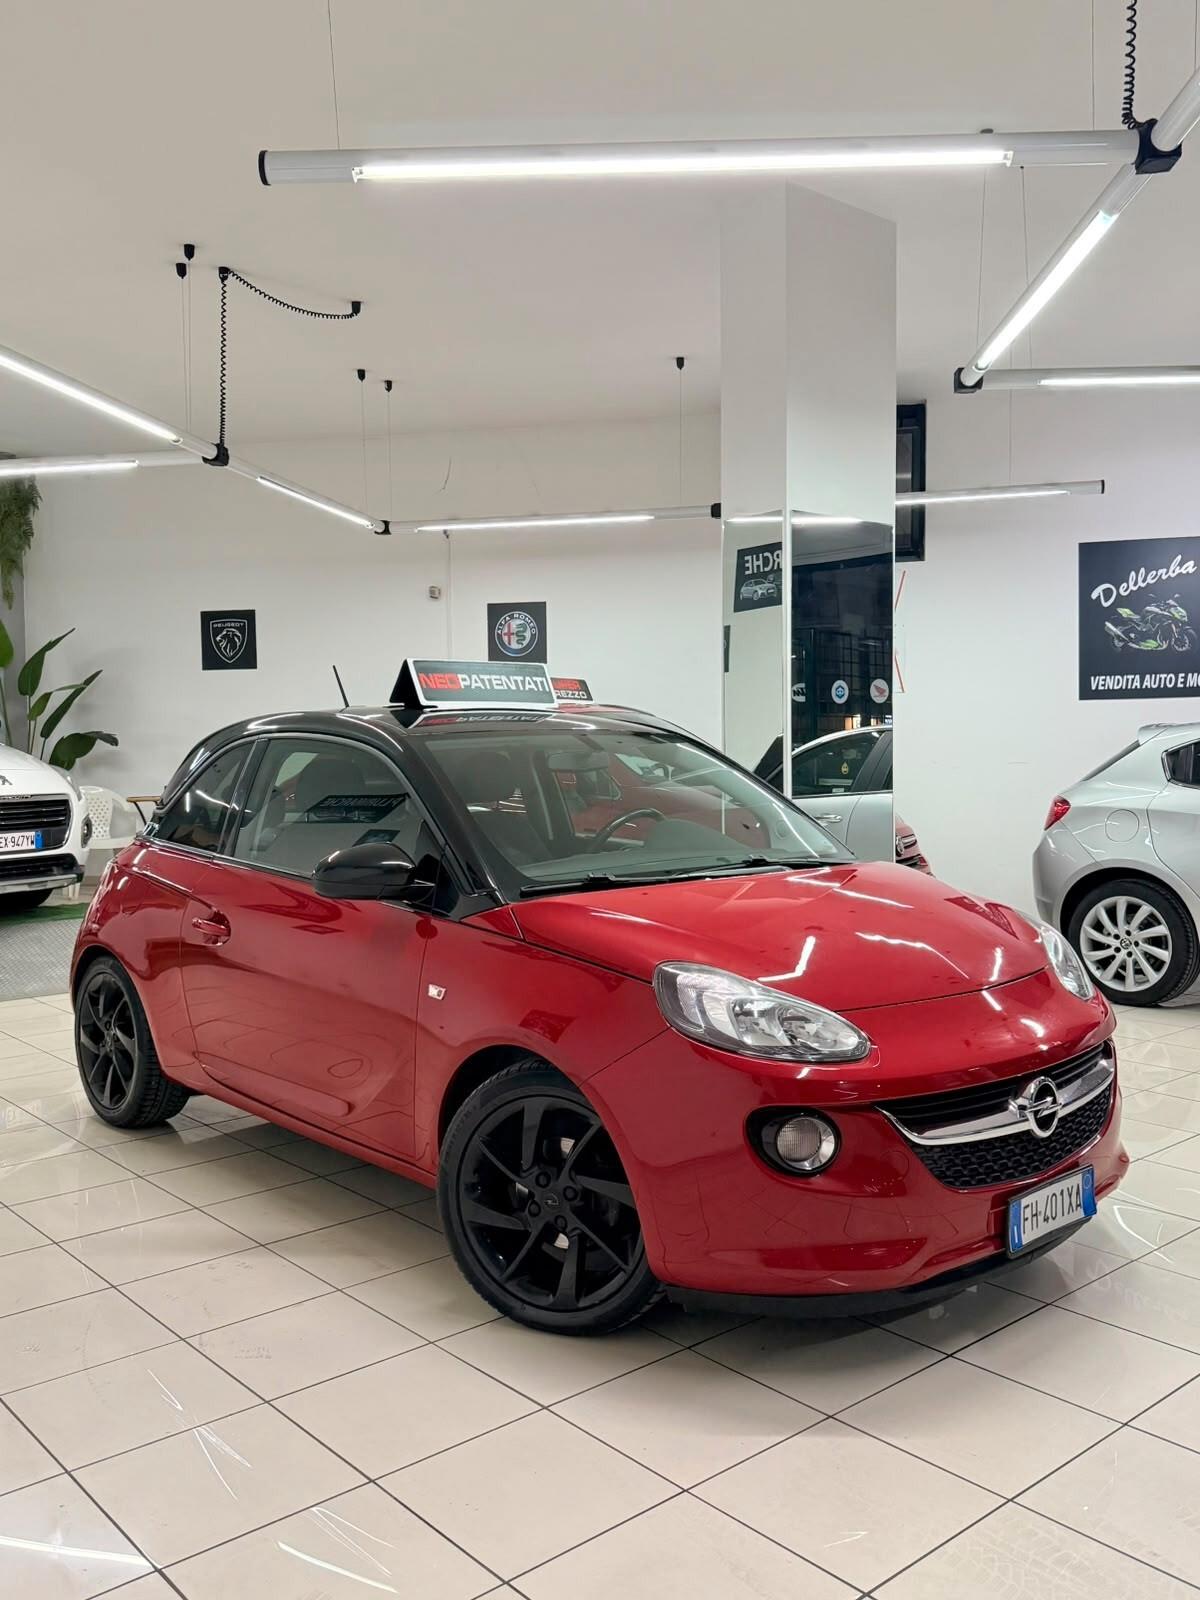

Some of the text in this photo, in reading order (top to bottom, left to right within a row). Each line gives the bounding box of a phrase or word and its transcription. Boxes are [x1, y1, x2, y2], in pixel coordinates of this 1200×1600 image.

[1090, 554, 1198, 607] Dellerba
[418, 672, 550, 692] NEOPATENTATI
[1090, 675, 1140, 690] VENDITA
[1142, 673, 1176, 690] AUTO
[1177, 673, 1185, 688] E
